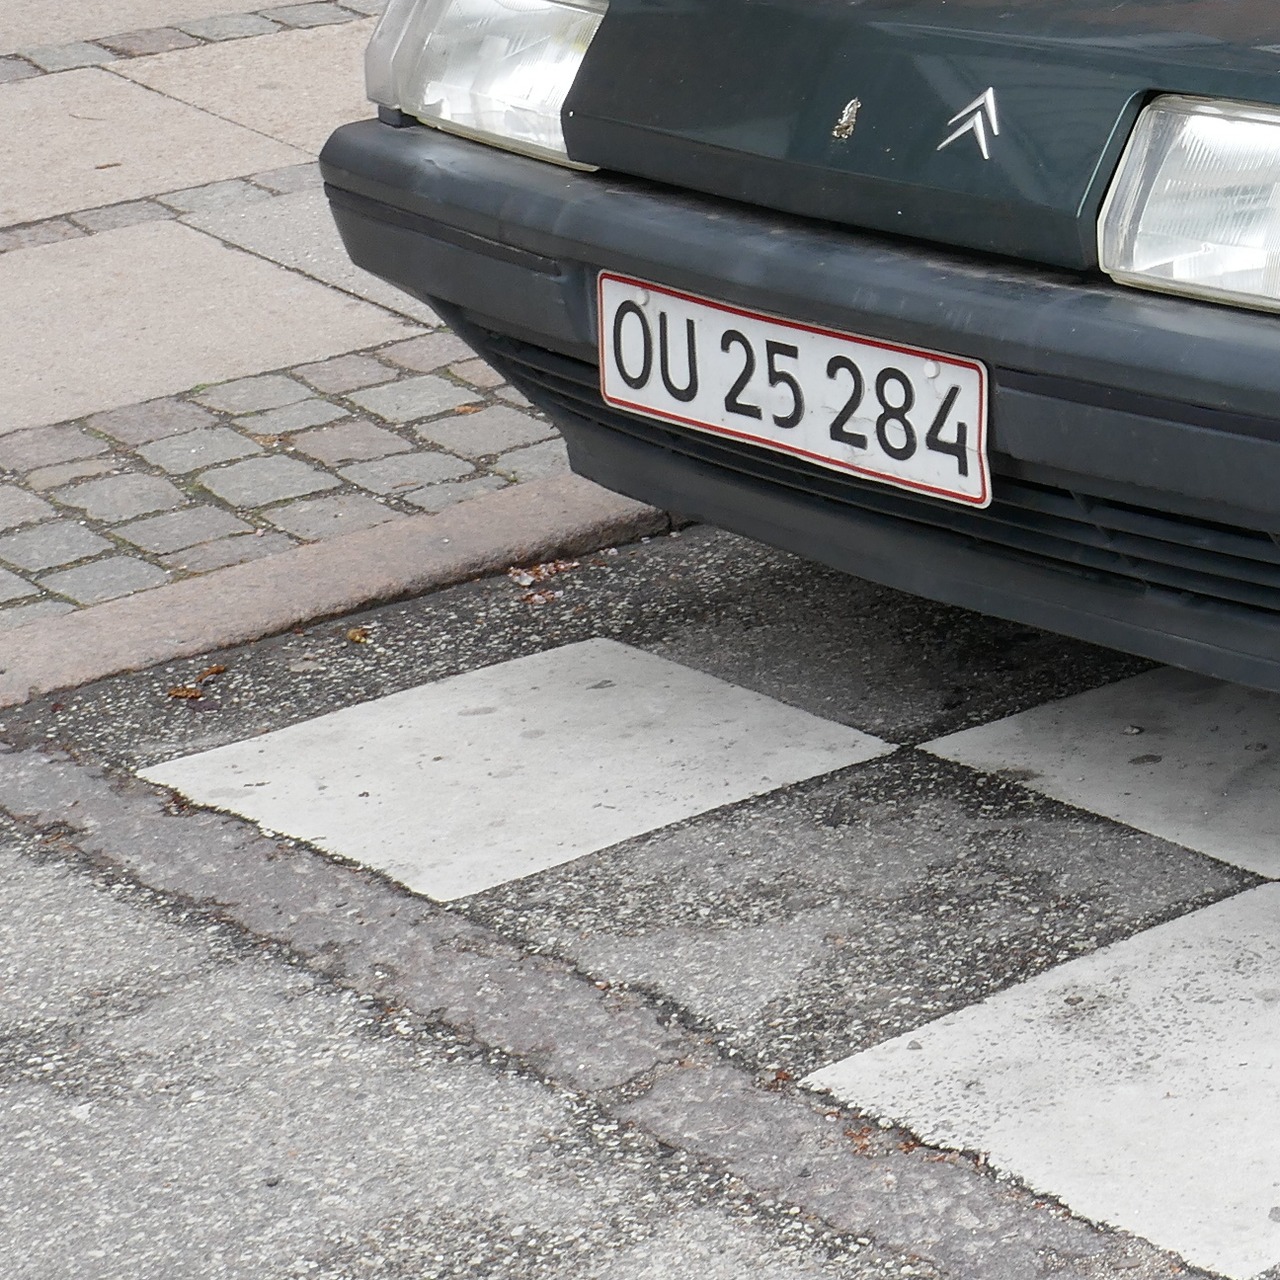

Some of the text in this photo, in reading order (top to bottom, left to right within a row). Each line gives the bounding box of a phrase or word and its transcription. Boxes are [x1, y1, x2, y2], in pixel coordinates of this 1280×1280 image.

[612, 299, 968, 477] OU 25 284
